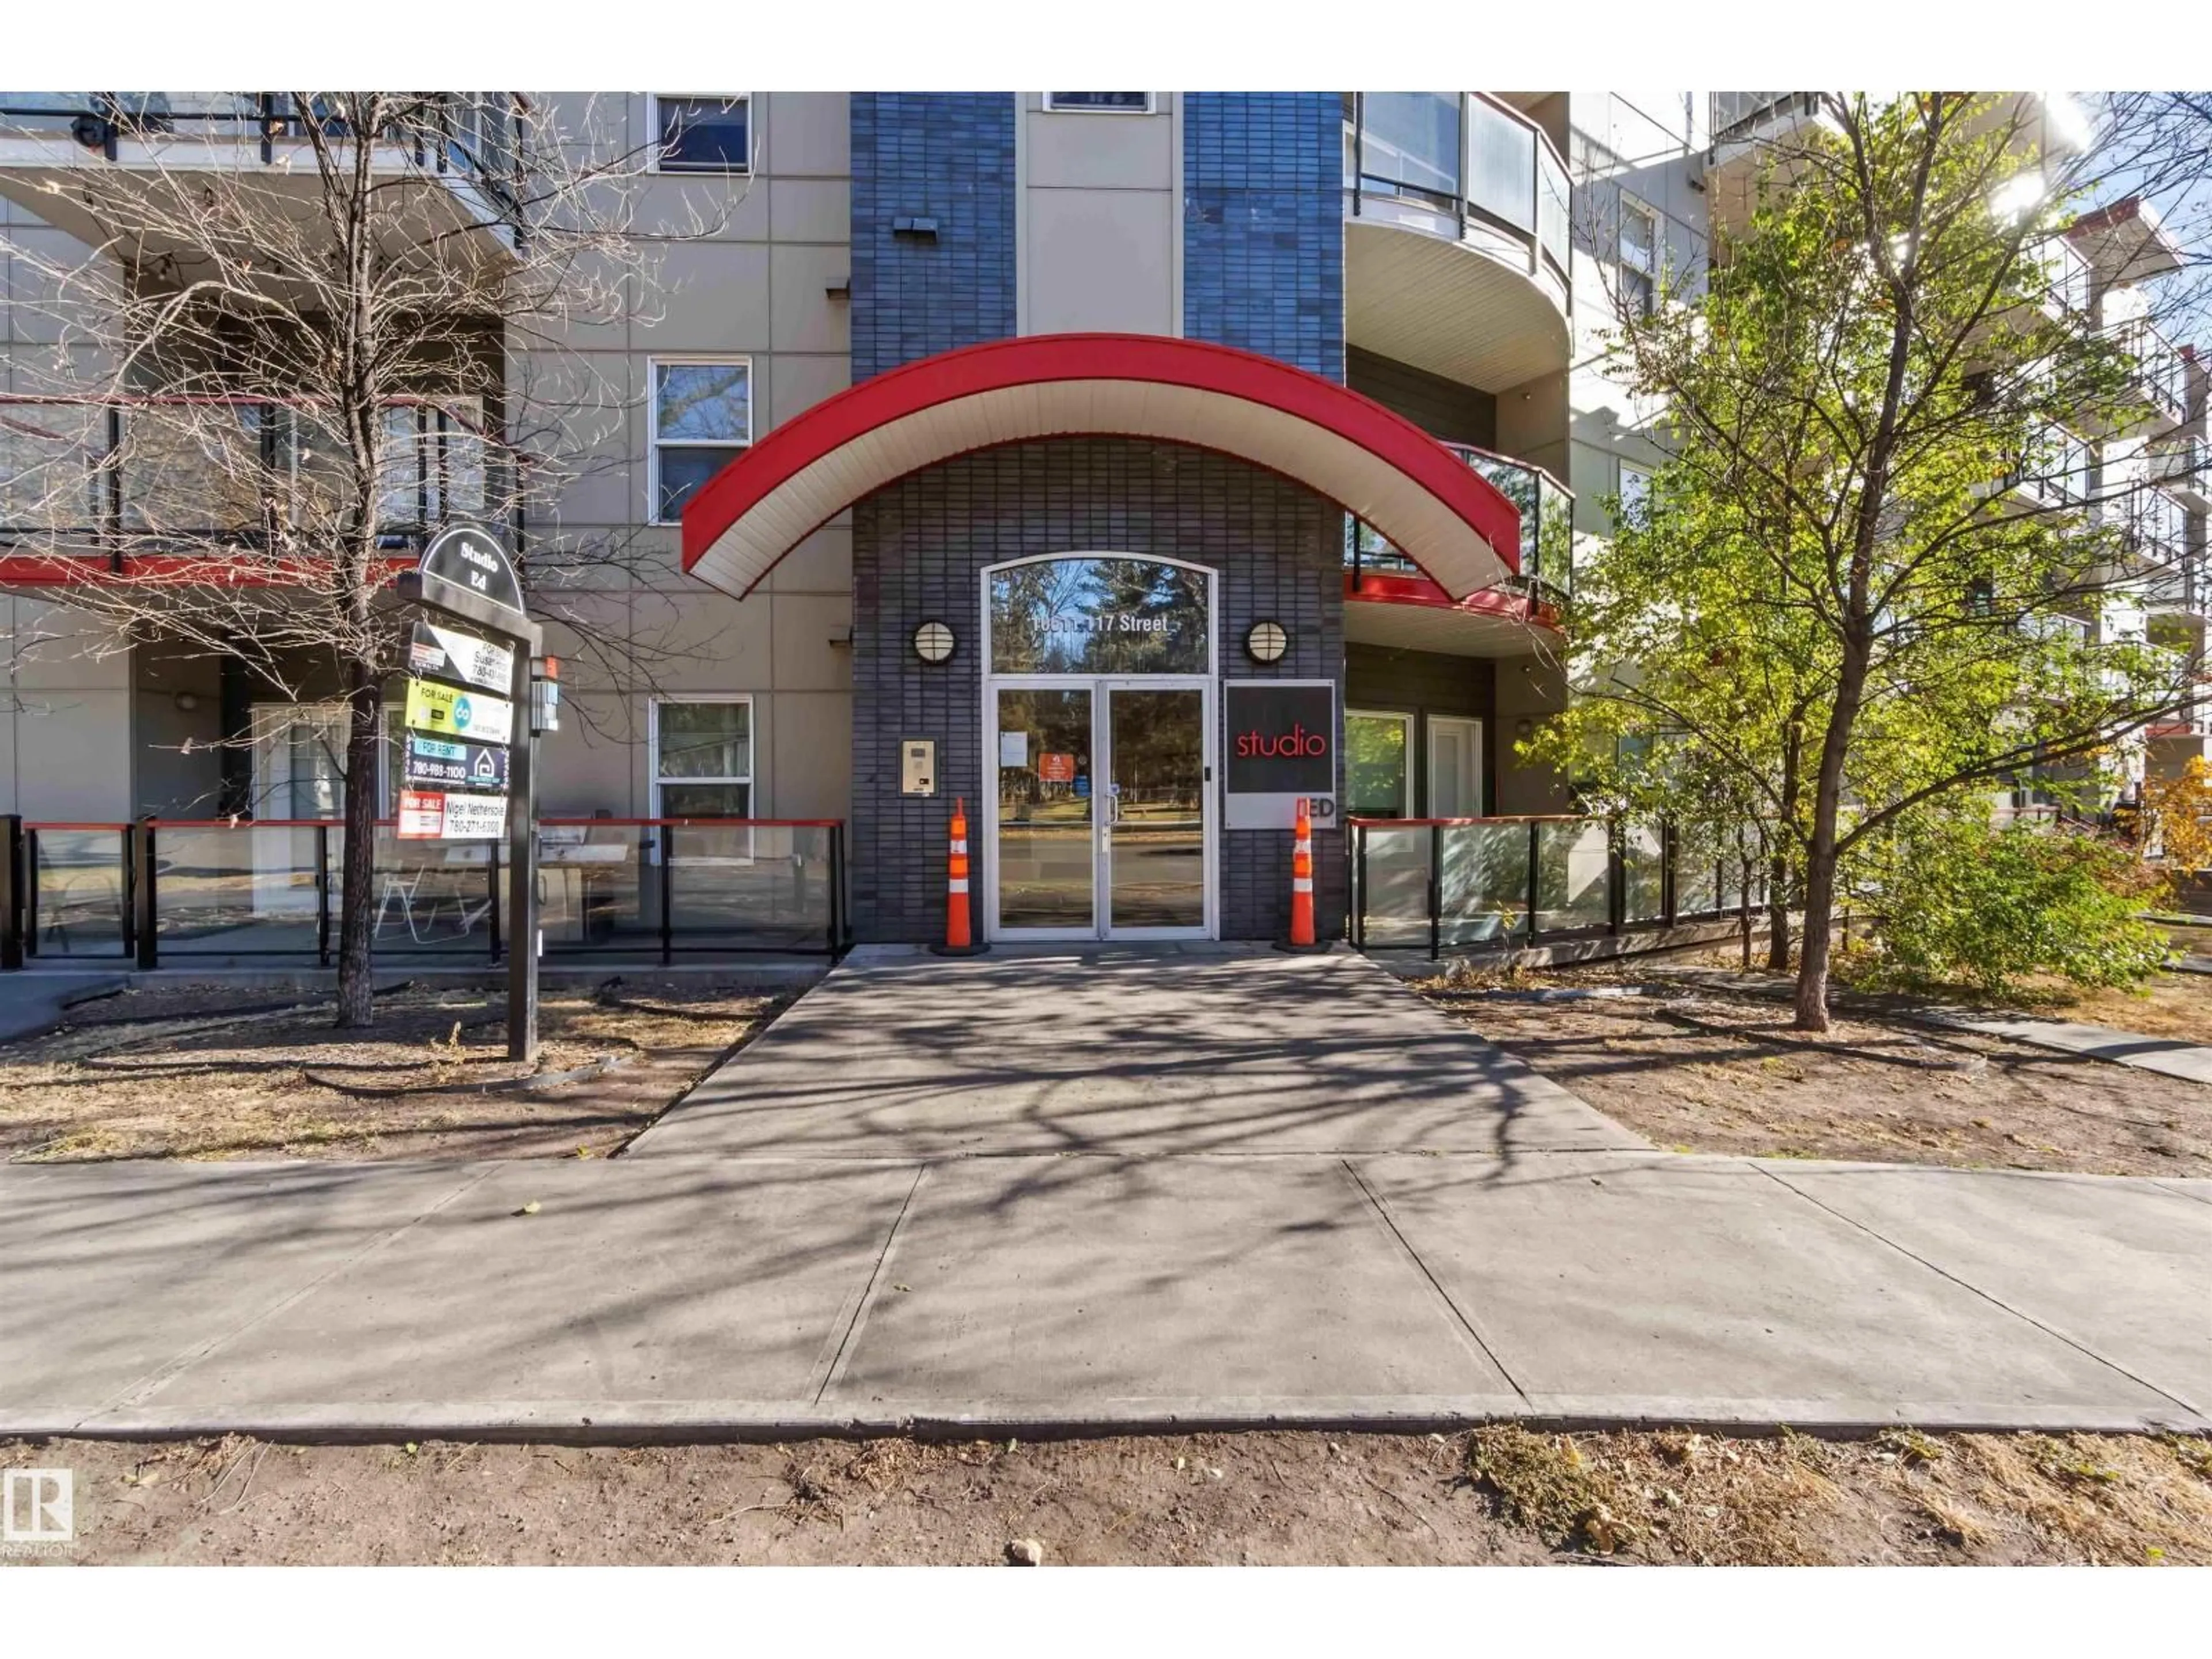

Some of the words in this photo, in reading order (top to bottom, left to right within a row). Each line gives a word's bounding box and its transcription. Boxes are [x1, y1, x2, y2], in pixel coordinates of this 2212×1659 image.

[460, 541, 499, 573] Studio
[470, 571, 486, 590] Ed
[1089, 615, 1114, 632] 117
[1119, 614, 1168, 632] Street
[421, 687, 436, 699] FOR
[437, 692, 453, 703] SALE
[423, 741, 435, 753] FOR
[1237, 723, 1326, 756] studio
[422, 798, 442, 810] SALE
[446, 800, 465, 817] Nigel
